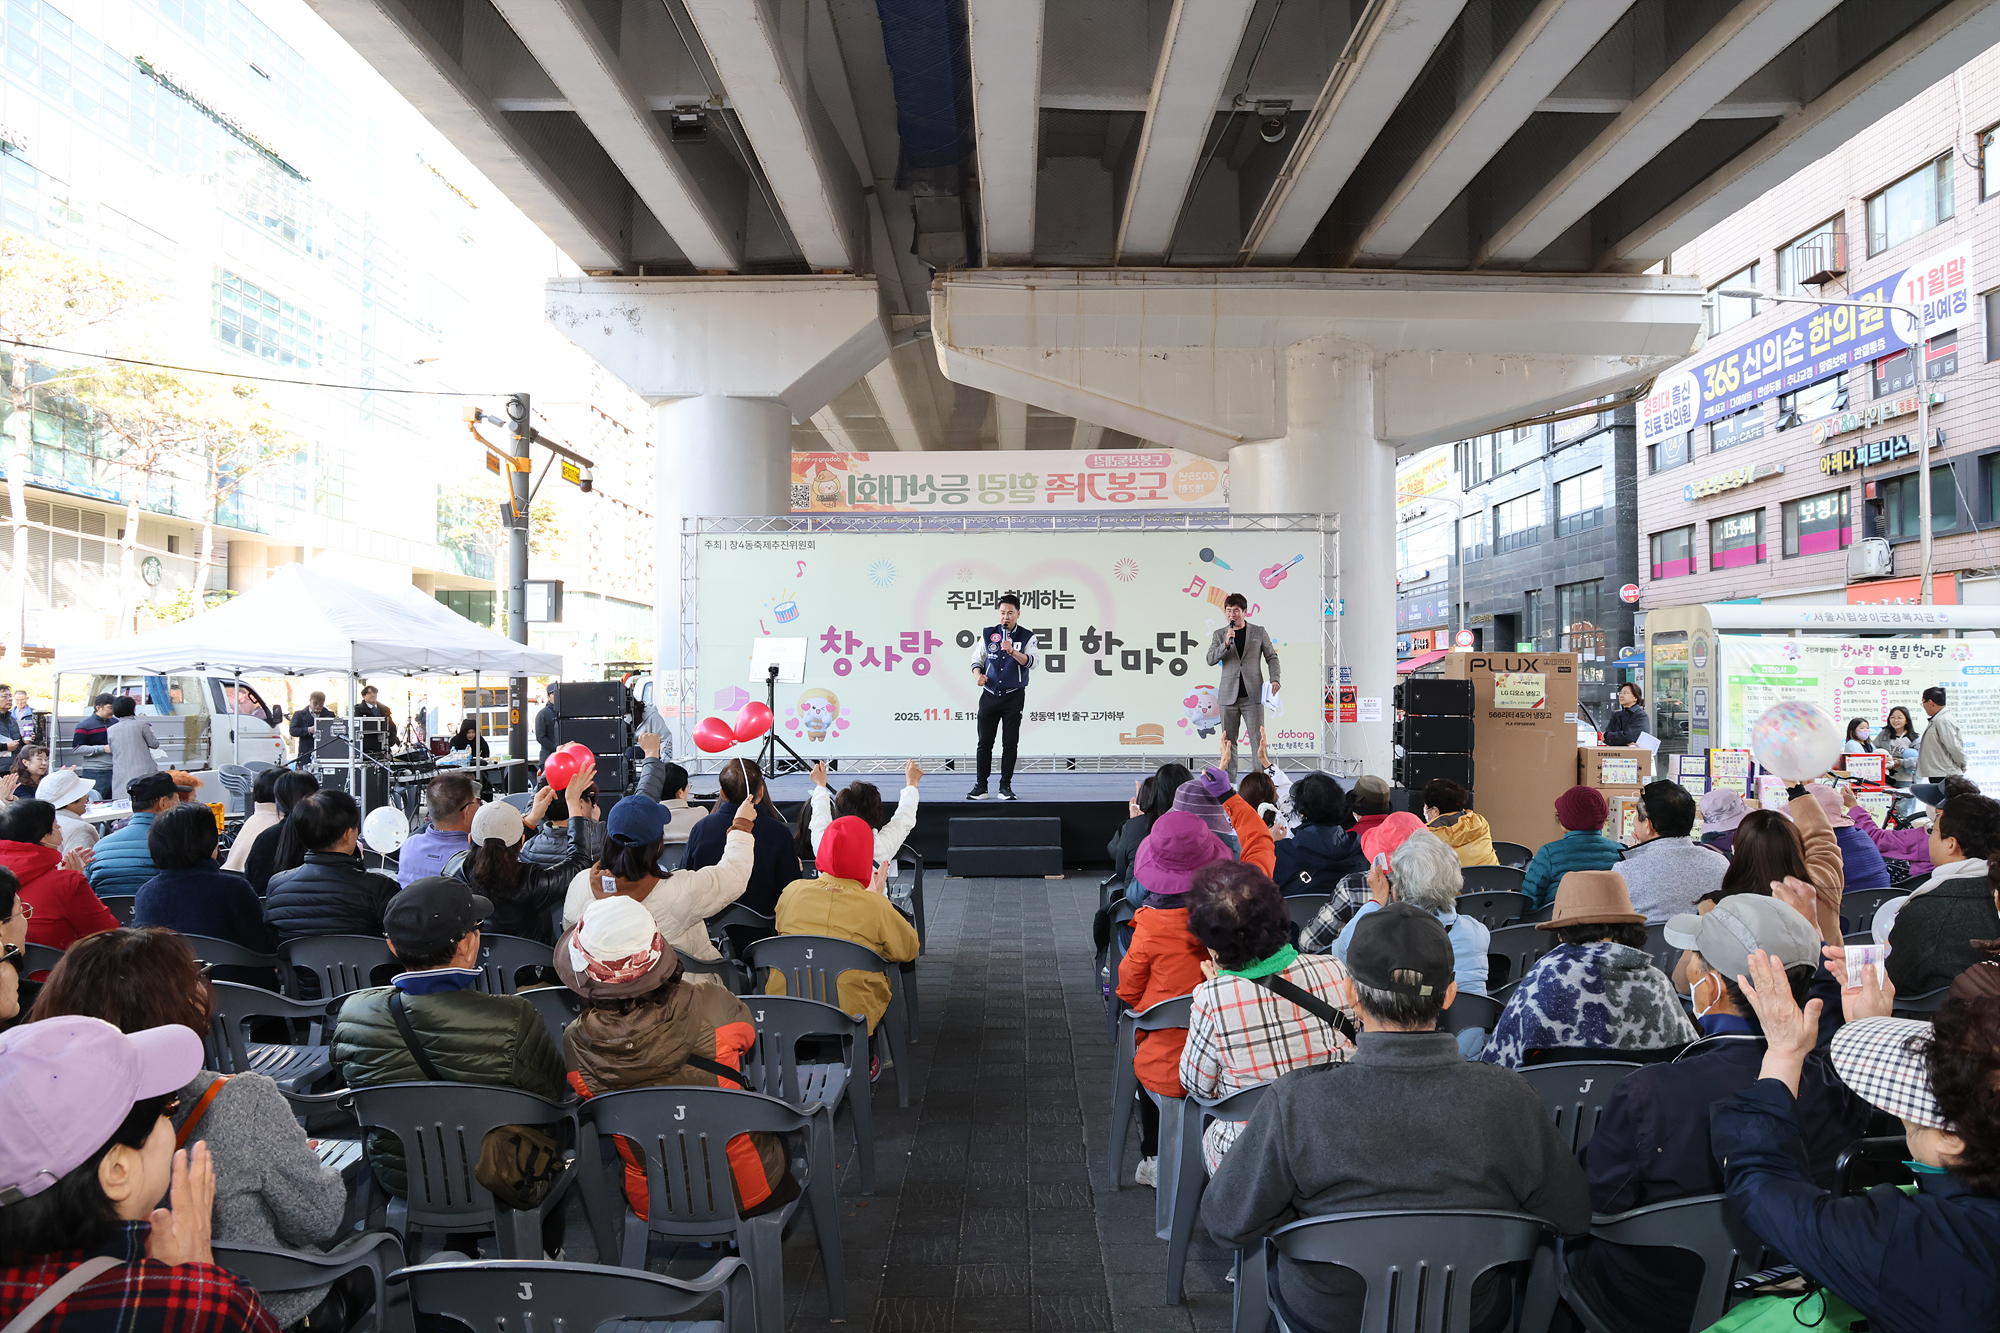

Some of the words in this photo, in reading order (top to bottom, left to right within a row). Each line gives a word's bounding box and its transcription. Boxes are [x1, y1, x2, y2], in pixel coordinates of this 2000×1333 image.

[1907, 255, 1966, 305] 11월말
[1703, 353, 1741, 401] 365
[1742, 327, 1805, 384] 신의손
[1808, 286, 1885, 357] 한의원
[1853, 337, 1886, 360] 관절통증
[1818, 352, 1848, 374] 맞춤보약
[1786, 366, 1813, 386] 추나교정
[1757, 379, 1782, 398] 만성두통
[1643, 389, 1670, 417] 경희대
[1672, 380, 1690, 406] 출신
[1729, 391, 1753, 408] 다이어트
[1703, 401, 1726, 418] 교통사고
[1644, 415, 1663, 439] 진료
[1663, 403, 1691, 431] 한의원
[1826, 413, 1857, 437] 7080
[1739, 426, 1763, 442] CAFE
[1820, 447, 1856, 475] 아레나
[1856, 435, 1909, 467] 피트니스
[1800, 494, 1848, 523] 보청기
[704, 540, 722, 550] 주최
[729, 540, 816, 550] 창4동축제추진위원회
[946, 590, 1000, 610] 주민과
[1813, 612, 1935, 623] 서울시립상이군경복지관
[820, 625, 944, 677] 창사랑
[955, 628, 1067, 674] 어림
[1079, 624, 1199, 677] 한마당
[1840, 643, 1875, 658] 창사랑
[1878, 644, 1911, 659] 어울림
[1912, 643, 1947, 658] 한마당
[1469, 658, 1539, 672] PLUX
[1761, 665, 1787, 673] 진행순서
[1966, 666, 1992, 674] 도움주신
[894, 712, 922, 721] 2025.
[923, 708, 941, 721] 11.
[943, 708, 953, 721] 1.
[954, 712, 963, 721] 토
[965, 712, 978, 721] 11:
[1029, 711, 1056, 721] 창동역
[1057, 711, 1070, 721] 1번
[1071, 711, 1089, 721] 출구
[1090, 711, 1125, 721] 고가하부
[1515, 711, 1532, 719] 4도어
[1533, 711, 1552, 719] 냉장고
[1277, 729, 1315, 741] dobong
[1286, 742, 1304, 750] 행복한
[483, 946, 491, 958] J
[805, 948, 814, 960] J
[755, 1010, 766, 1023] J
[1579, 1078, 1594, 1094] J
[673, 1105, 686, 1121] J
[517, 1282, 534, 1301] J
